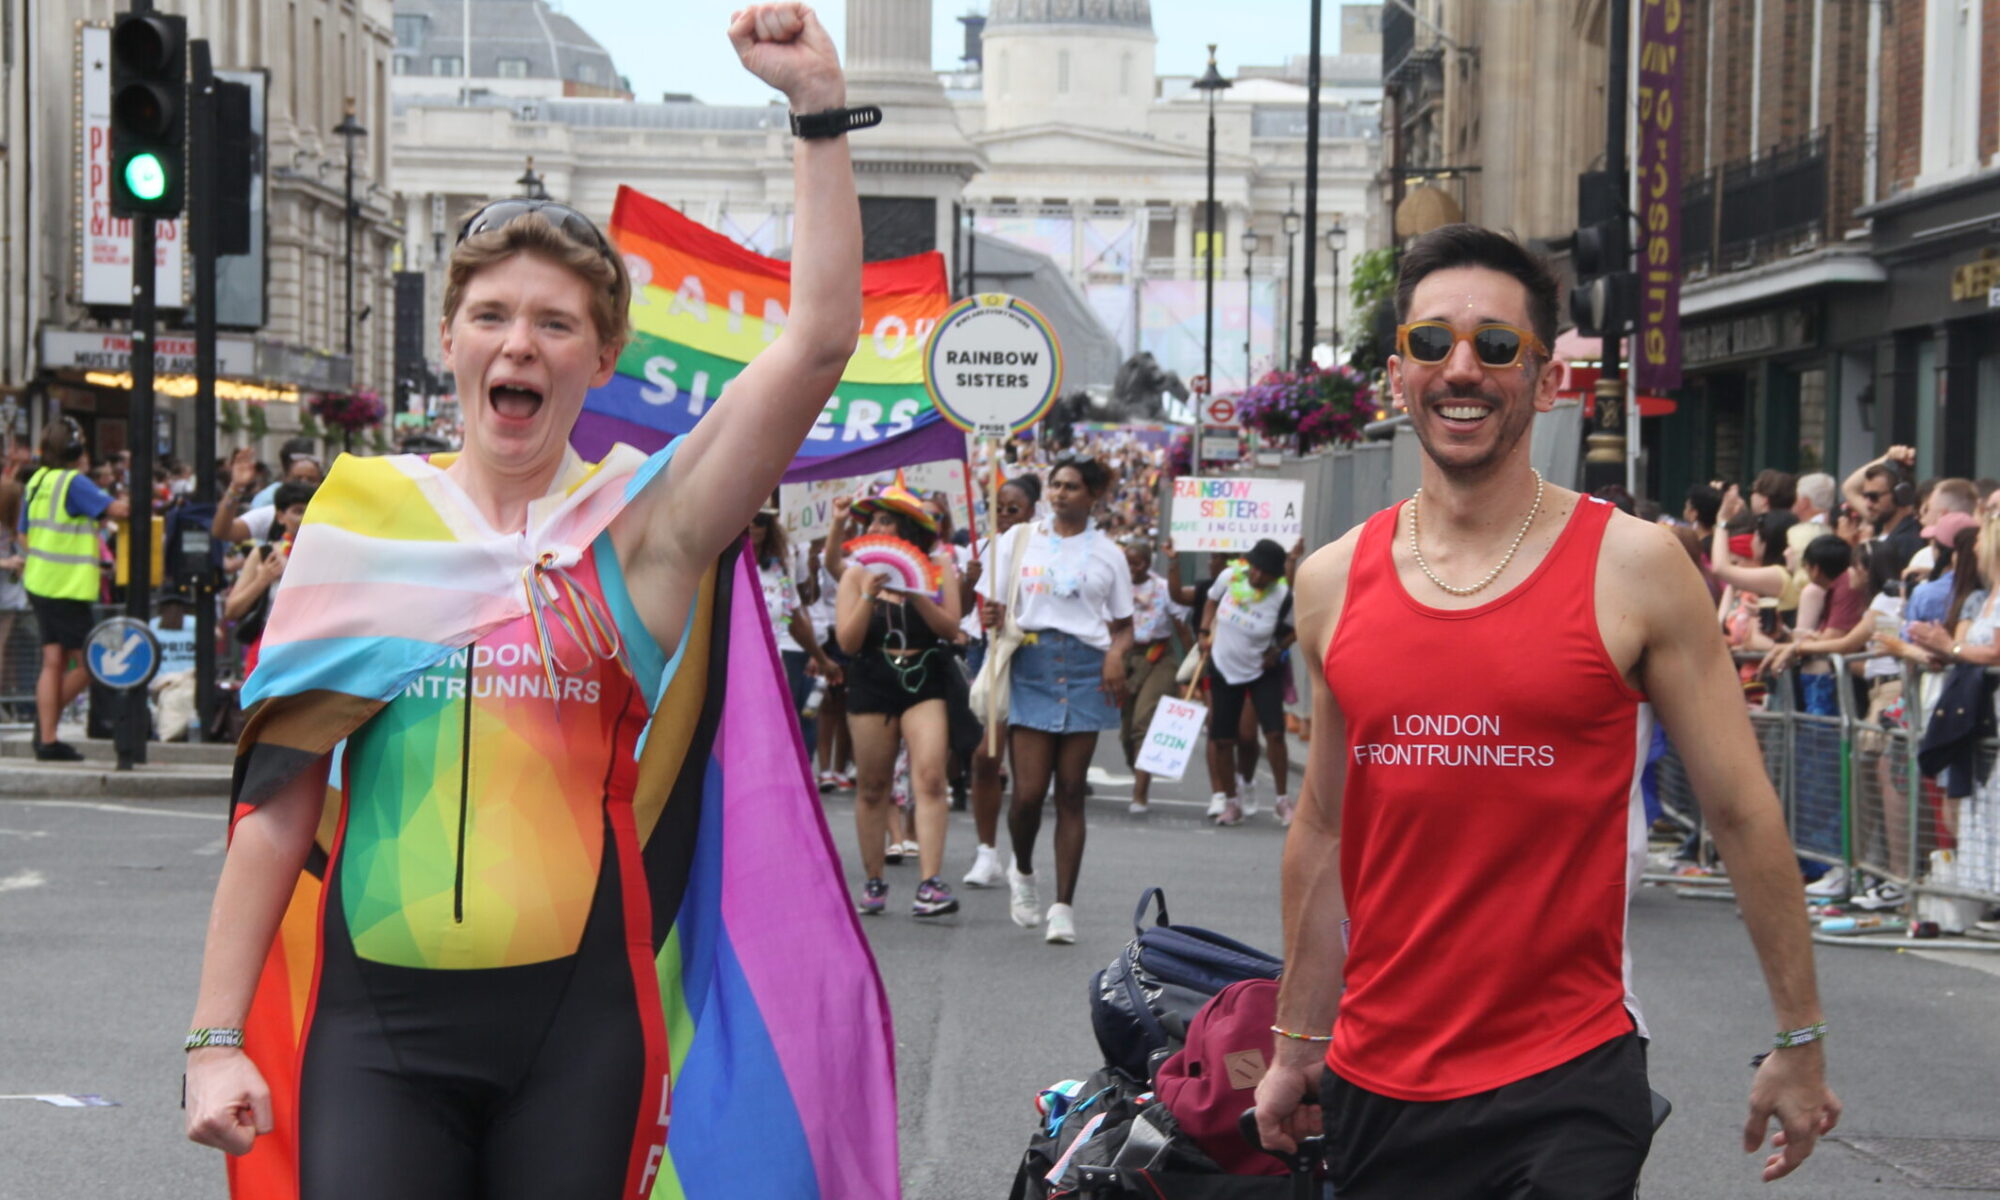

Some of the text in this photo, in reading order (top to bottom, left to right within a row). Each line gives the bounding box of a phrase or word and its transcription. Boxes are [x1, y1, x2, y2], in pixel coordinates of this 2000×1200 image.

[624, 254, 938, 360] RAINOW
[75, 352, 112, 367] MUST
[946, 351, 1038, 365] RAINBOW
[956, 373, 1029, 388] SISTERS
[640, 355, 920, 442] SIERS
[1173, 481, 1252, 498] RAINBOW
[787, 500, 826, 532] LOV
[1201, 500, 1295, 519] SISTERS A
[1208, 522, 1300, 533] INCLUSIVE
[1198, 537, 1250, 550] FAMIL
[160, 641, 195, 652] PRID
[1393, 714, 1500, 736] LONDON
[1354, 744, 1555, 767] FRONTRUNNERS
